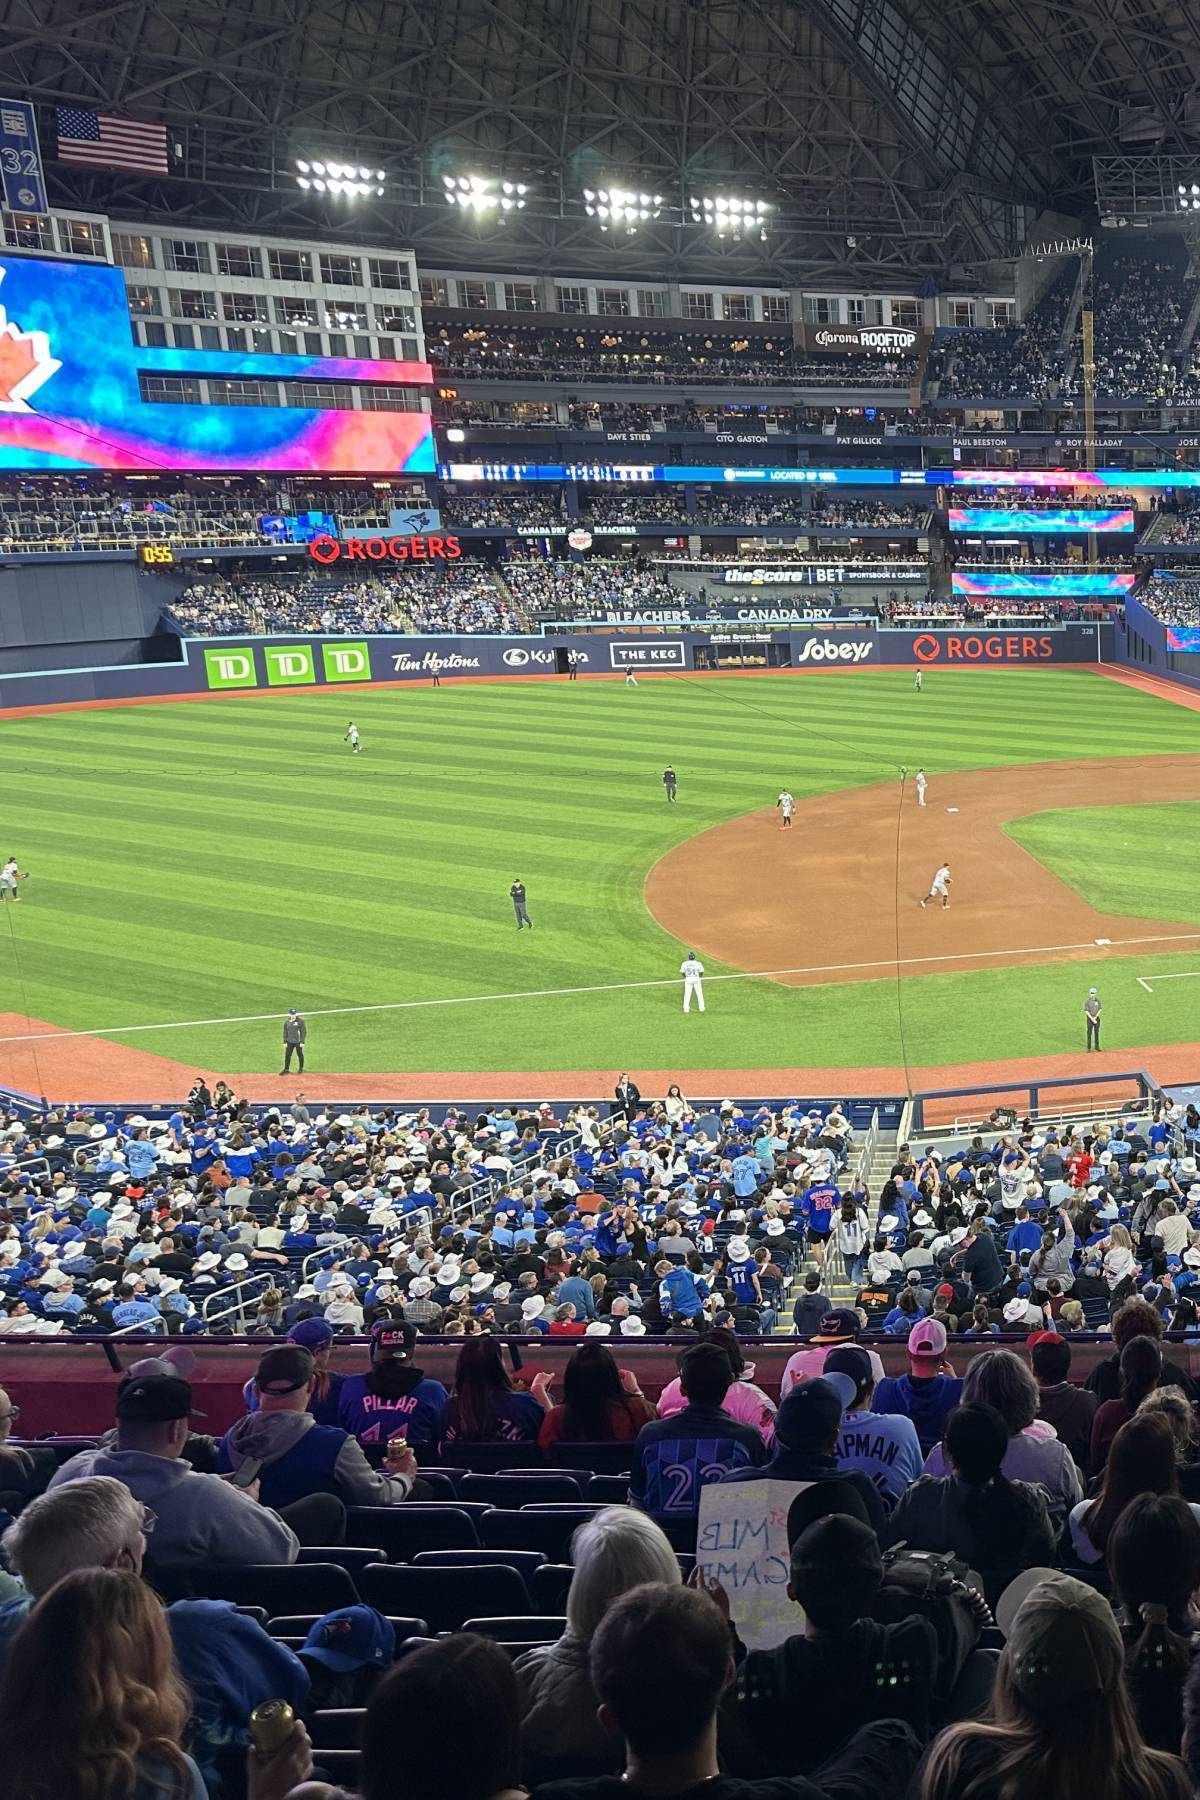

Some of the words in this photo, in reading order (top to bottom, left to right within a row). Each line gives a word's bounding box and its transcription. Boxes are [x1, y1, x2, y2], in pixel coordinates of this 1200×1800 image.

[1, 147, 40, 177] 32
[815, 330, 859, 347] Corona
[860, 332, 916, 347] ROOFTOP
[876, 346, 901, 354] PATIO
[607, 433, 627, 441] DAVE
[629, 433, 651, 441] STIEB
[716, 435, 734, 443] CITO
[736, 435, 768, 443] GASTON
[836, 437, 851, 445] PAT
[852, 437, 882, 445] GILLICK
[953, 438, 972, 446] PAUL
[973, 438, 1007, 446] BEESTON
[1066, 439, 1082, 447] ROY
[1084, 439, 1123, 447] HALLADAY
[1178, 438, 1199, 446] JOSÉ
[770, 471, 805, 481] LOCATED
[517, 527, 550, 535] CANADA
[551, 527, 567, 535] DRY
[594, 526, 636, 534] BLEACHERS
[349, 536, 462, 561] ROGERS
[725, 568, 803, 585] theScore
[817, 568, 845, 582] BET
[606, 610, 691, 623] BLEACHERS
[737, 609, 797, 620] CANADA
[798, 609, 832, 620] DRY
[710, 633, 731, 641] Active
[798, 637, 873, 662] Sobeys
[947, 636, 1053, 658] ROGERS
[531, 649, 590, 664] Kuta
[619, 650, 648, 660] THE
[650, 649, 677, 659] KEG
[209, 655, 251, 680] TD
[269, 652, 309, 677] TD
[327, 649, 366, 674] TD
[392, 653, 420, 671] Tim
[422, 652, 480, 670] Hortons
[713, 1189, 721, 1200] 4
[641, 1209, 657, 1222] 14
[843, 1221, 858, 1238] 11
[732, 1271, 746, 1284] 11
[362, 1394, 418, 1415] PILLAR
[832, 1433, 900, 1467] APMAN
